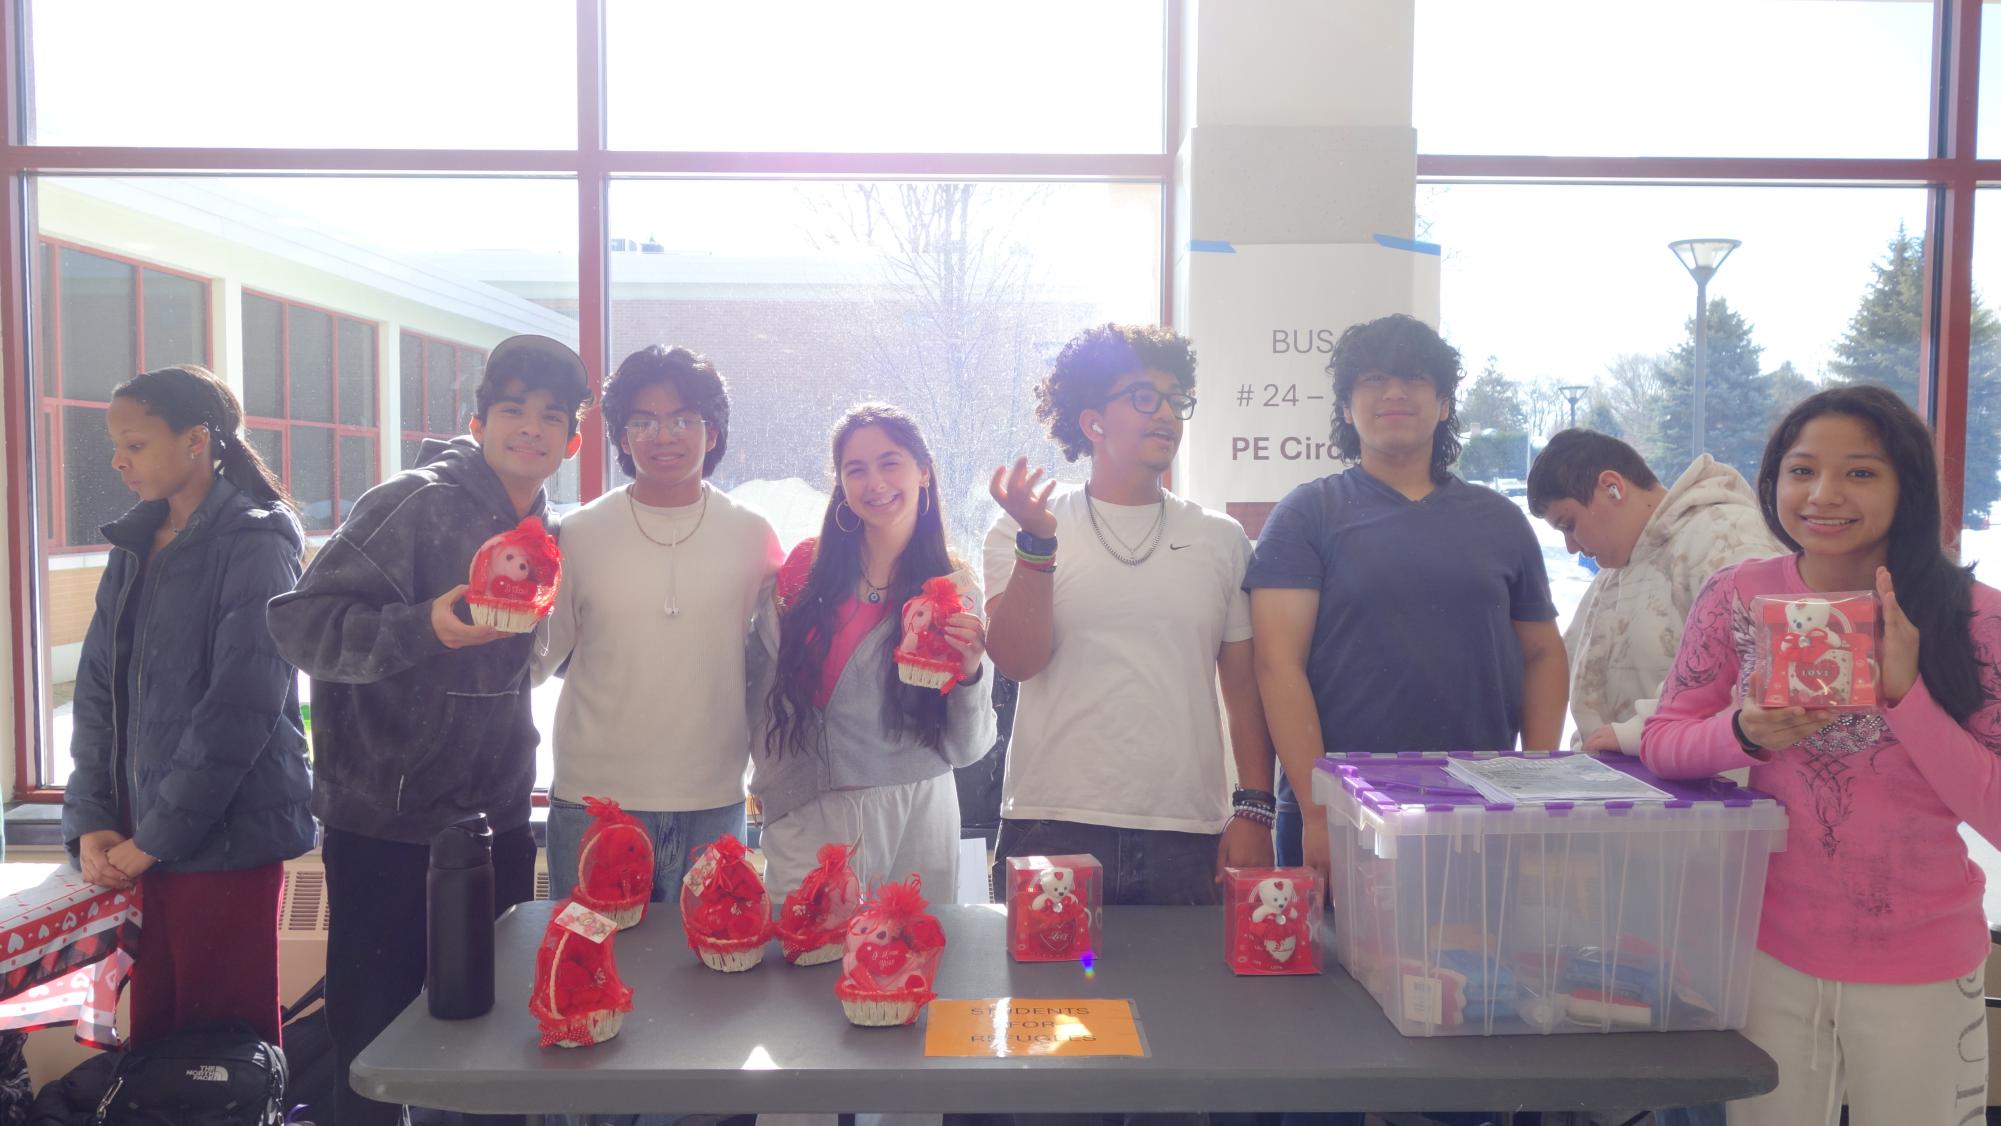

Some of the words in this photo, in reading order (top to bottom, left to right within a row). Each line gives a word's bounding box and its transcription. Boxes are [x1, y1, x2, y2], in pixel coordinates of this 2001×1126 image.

[1272, 329, 1334, 353] BUS
[1236, 383, 1255, 407] #
[1263, 384, 1299, 406] 24
[1232, 437, 1270, 460] PE
